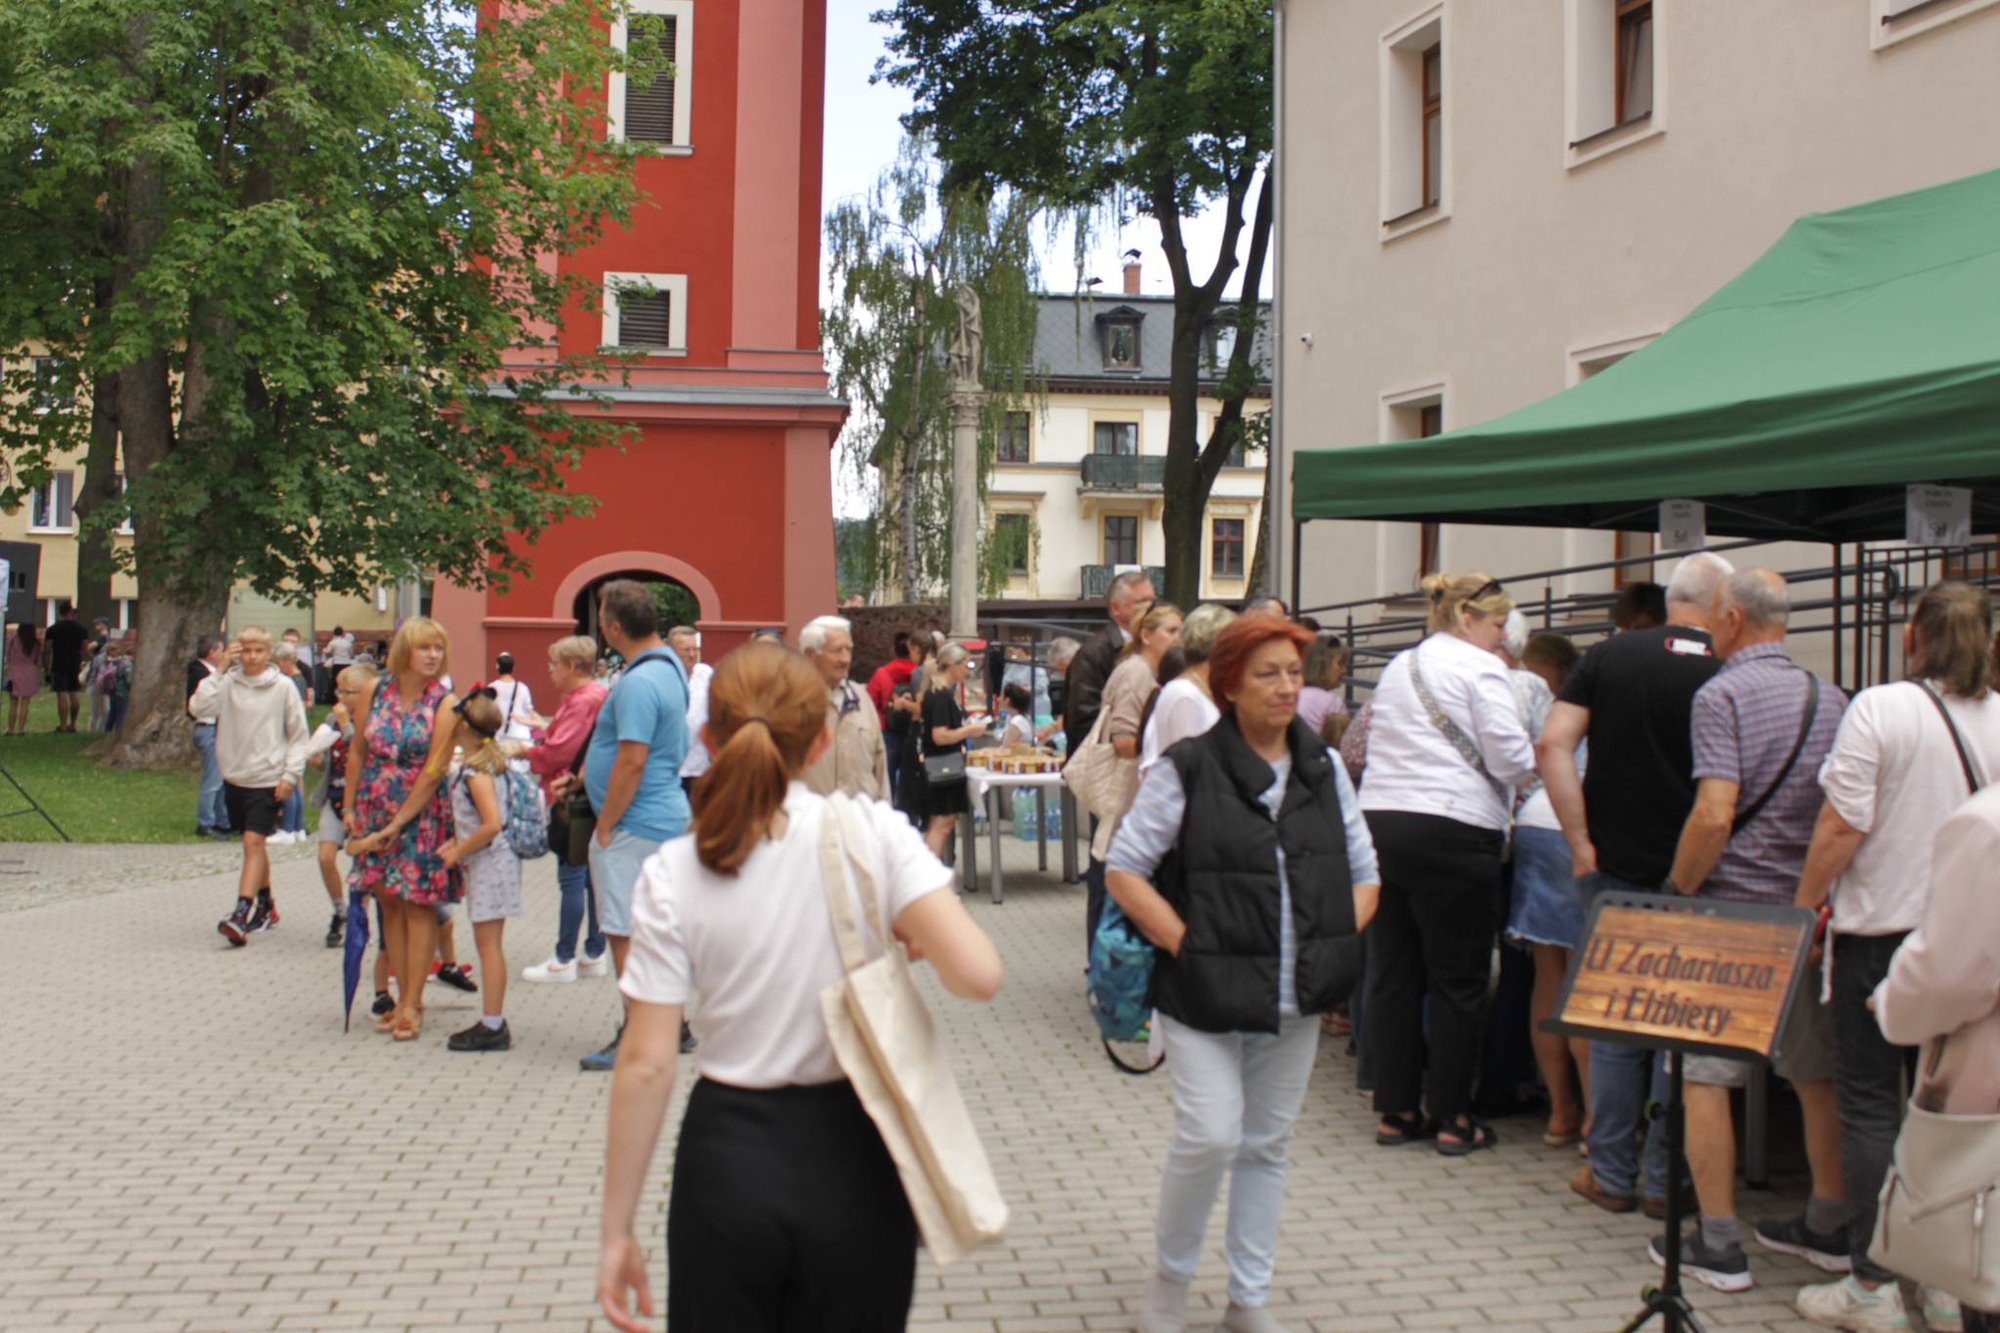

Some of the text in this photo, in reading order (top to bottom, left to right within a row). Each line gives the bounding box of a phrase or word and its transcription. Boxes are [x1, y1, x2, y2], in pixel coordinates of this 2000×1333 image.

[1618, 940, 1776, 990] Zachariasza
[1603, 986, 1731, 1037] i Elżbiety
